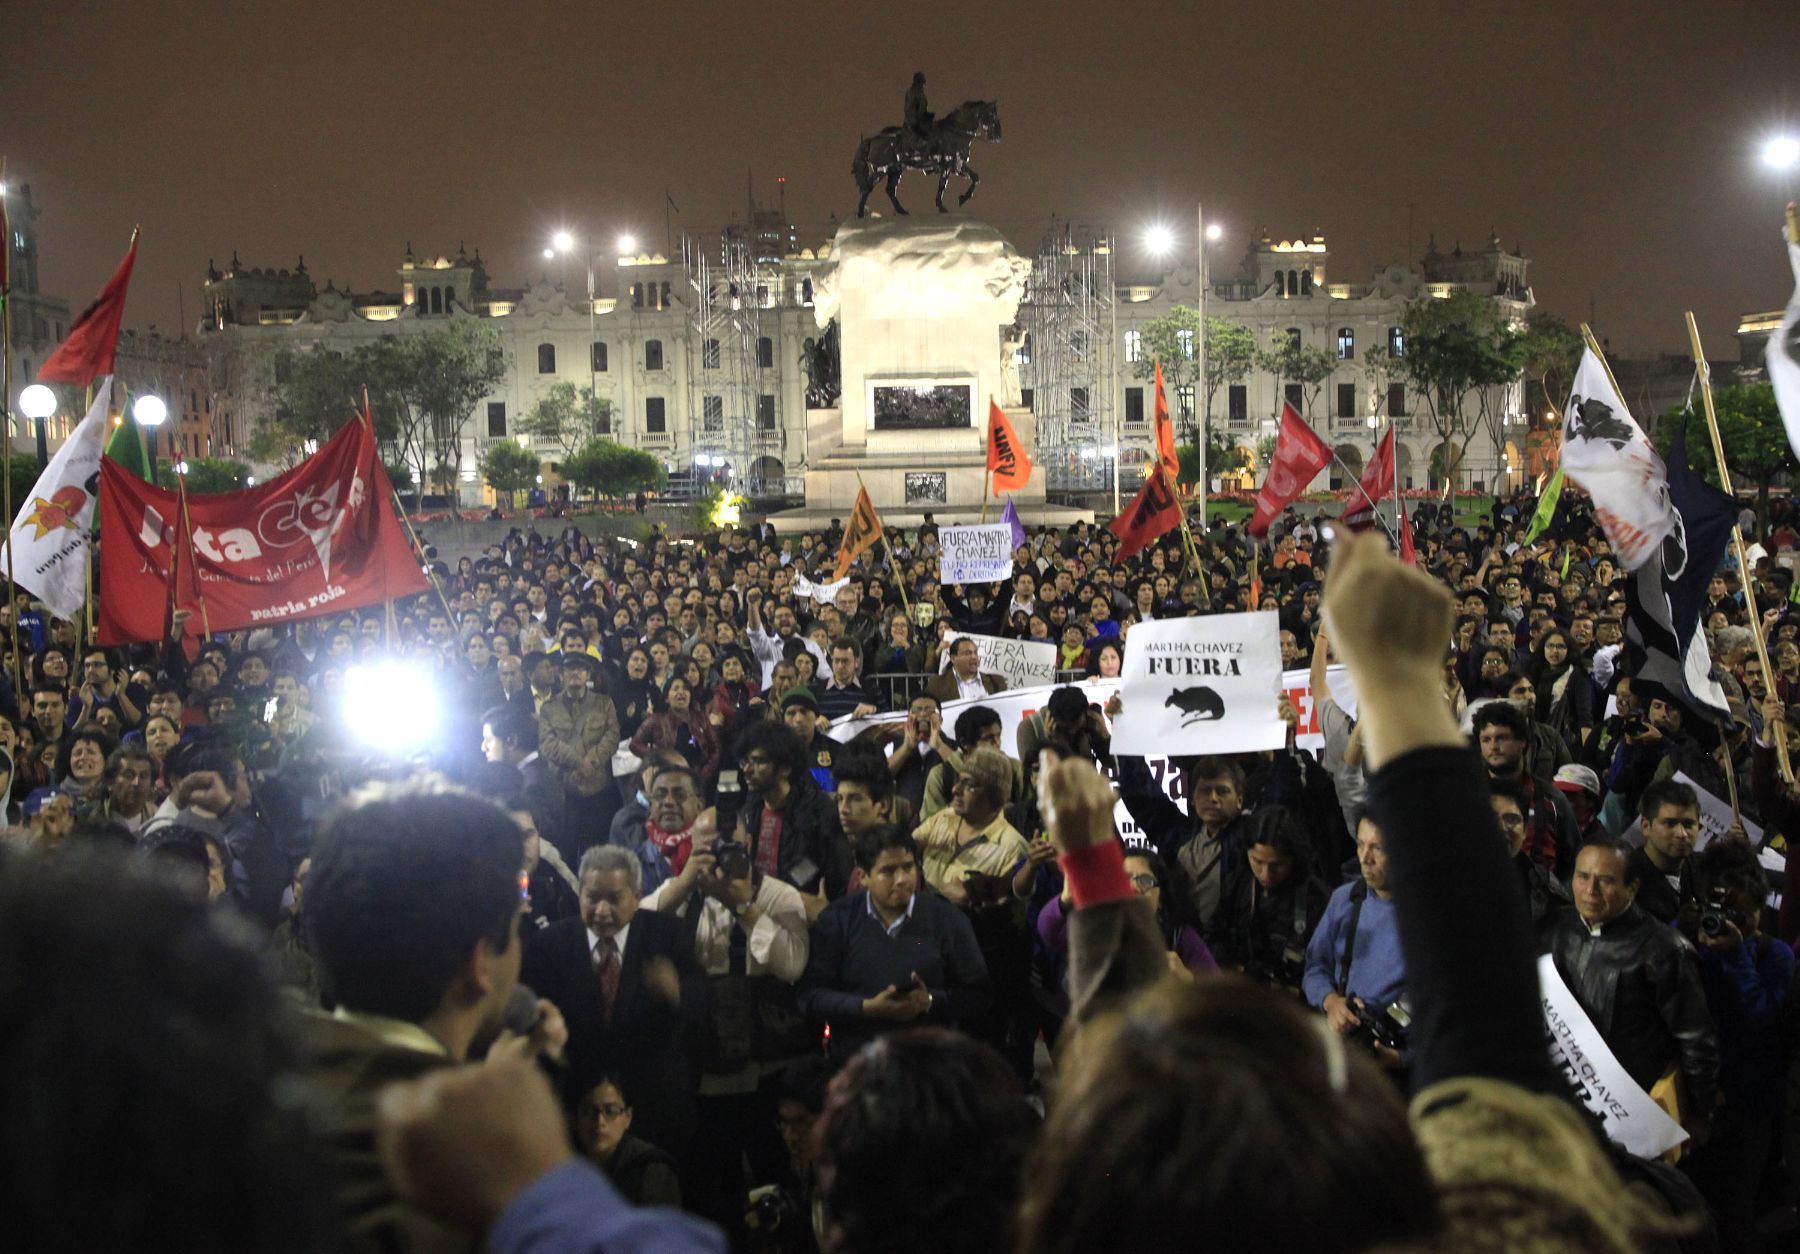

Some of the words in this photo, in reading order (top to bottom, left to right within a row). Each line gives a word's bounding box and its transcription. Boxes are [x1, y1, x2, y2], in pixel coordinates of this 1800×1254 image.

[249, 601, 307, 622] patria
[307, 584, 346, 609] roja
[1144, 642, 1191, 653] MARTHA
[1194, 642, 1244, 654] CHAVEZ
[1148, 656, 1242, 677] FUERA
[1543, 997, 1584, 1063] MARTHA
[1580, 1061, 1630, 1122] CHAVEZ
